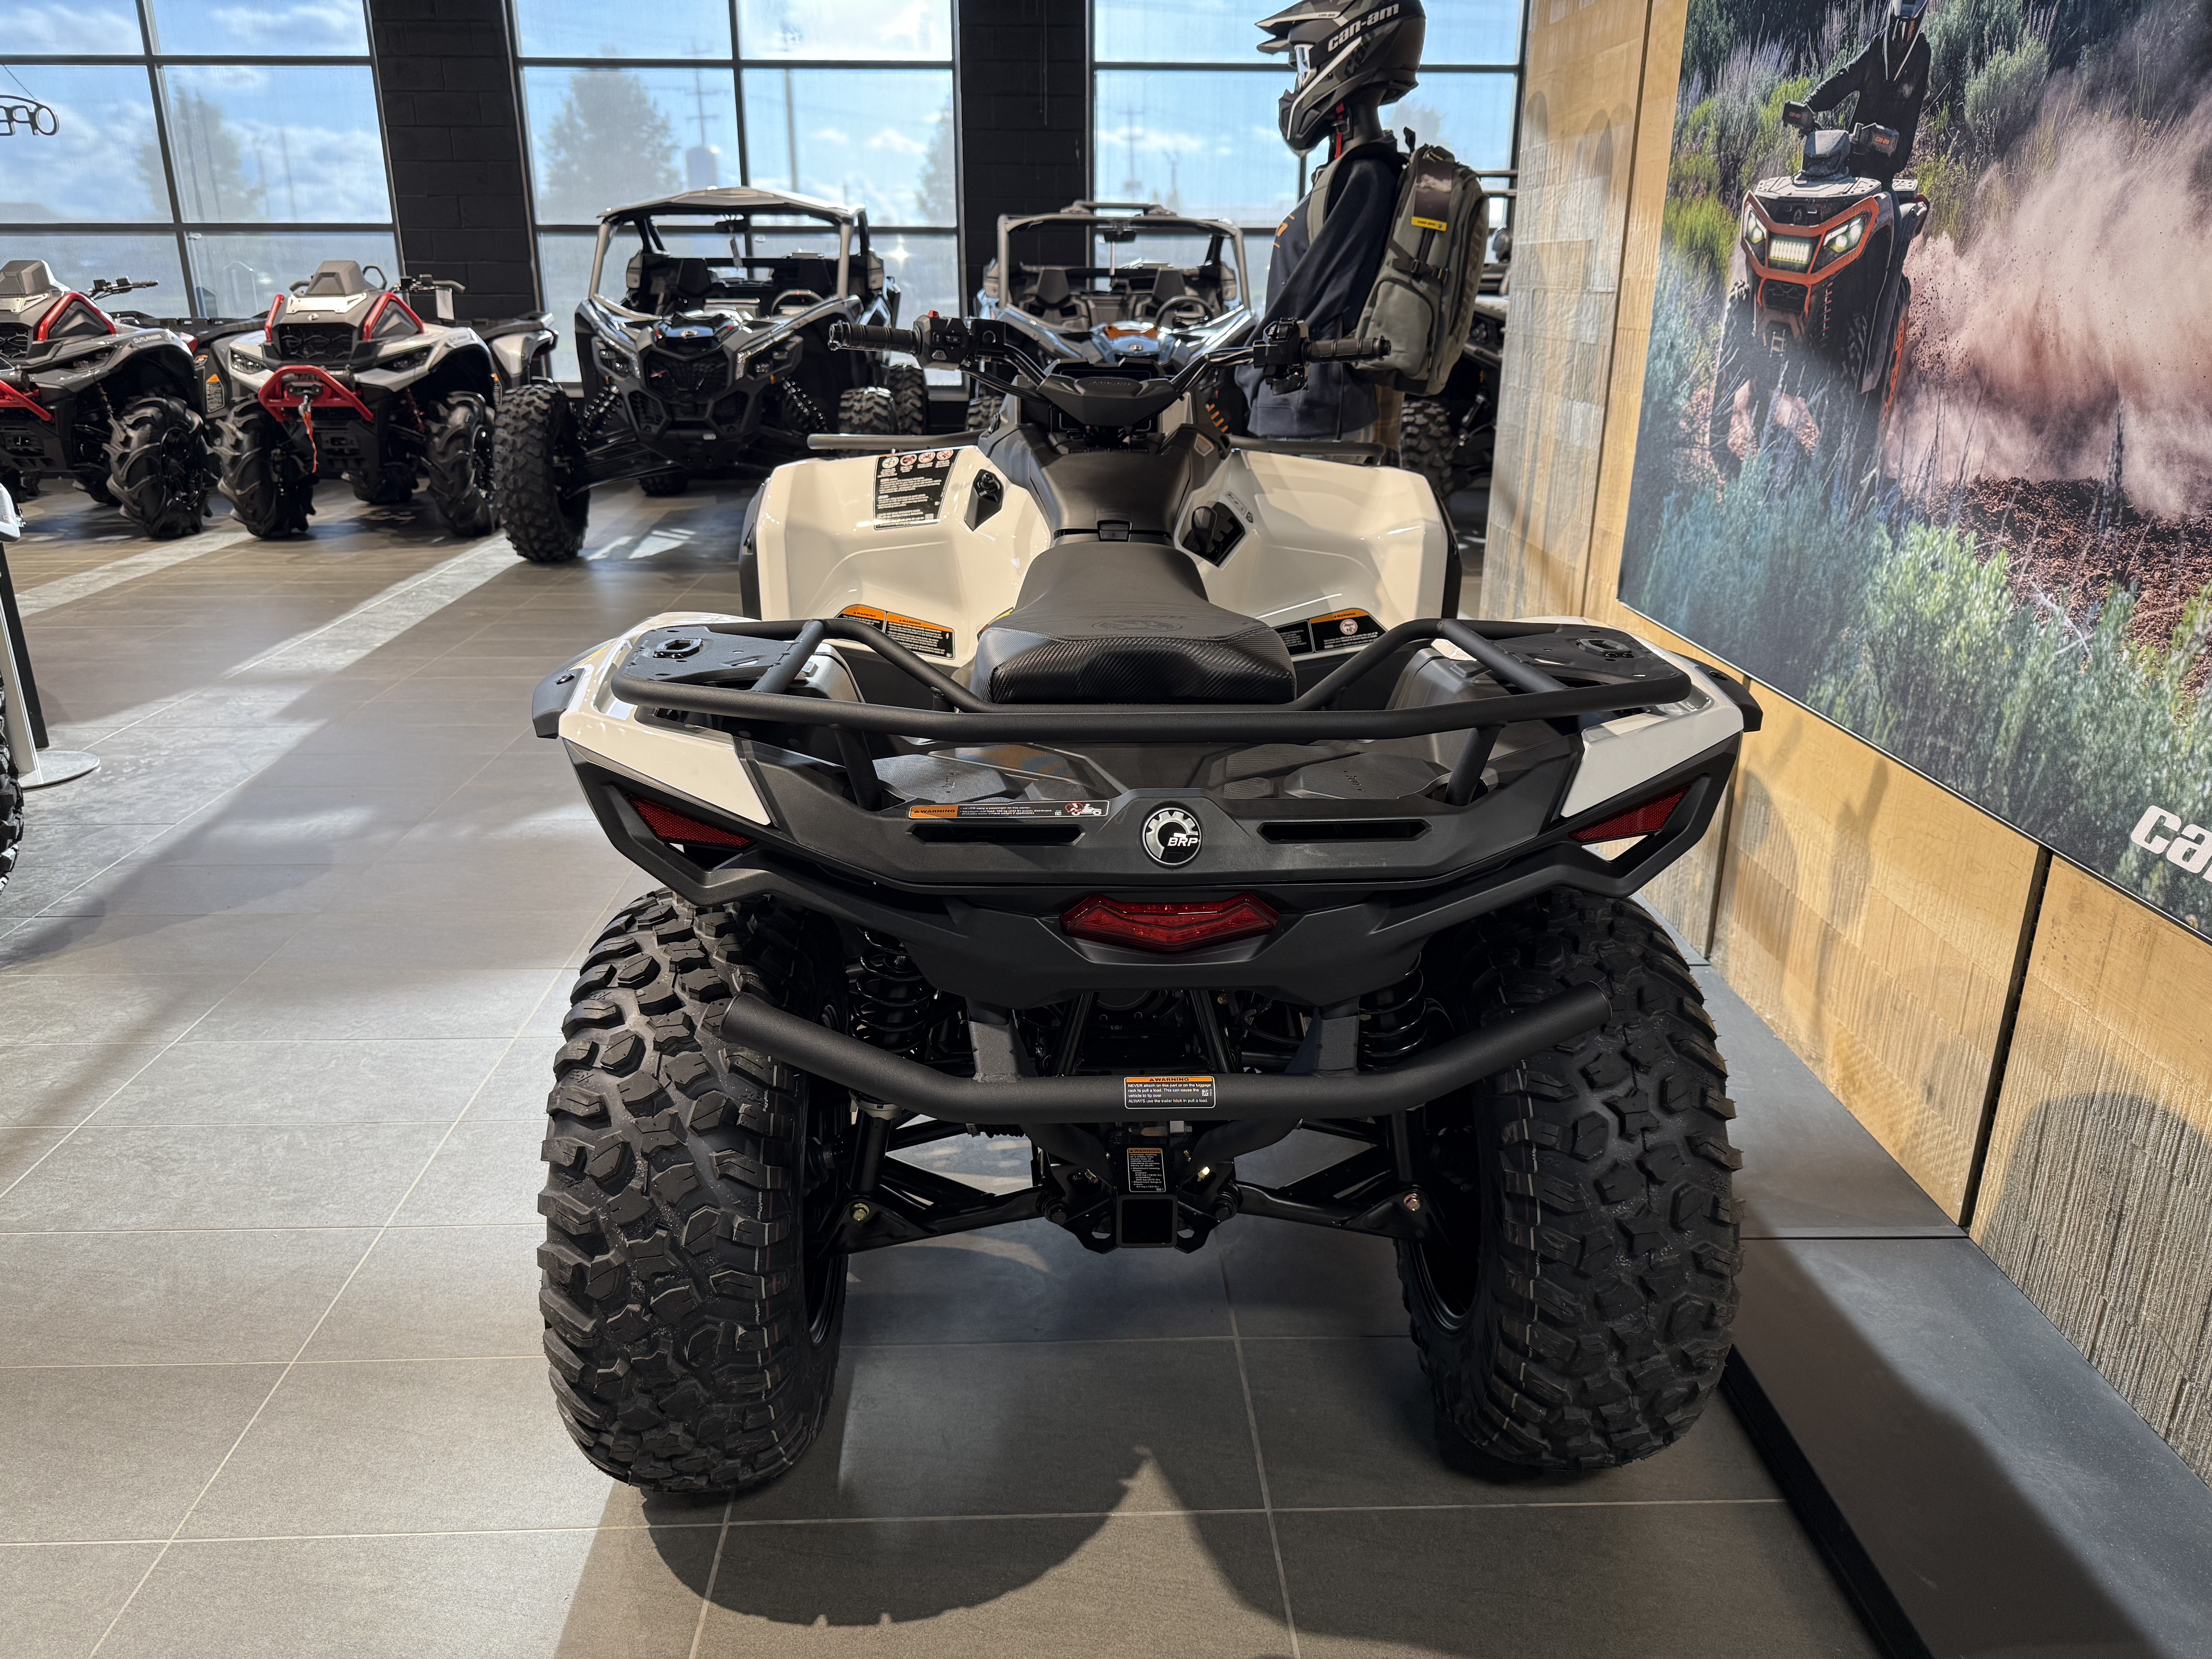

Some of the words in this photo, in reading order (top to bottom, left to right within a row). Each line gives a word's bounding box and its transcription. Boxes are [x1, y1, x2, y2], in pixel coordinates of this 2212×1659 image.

[1328, 3, 1399, 52] can-am
[1167, 837, 1198, 847] BRP
[2131, 805, 2212, 883] ca
